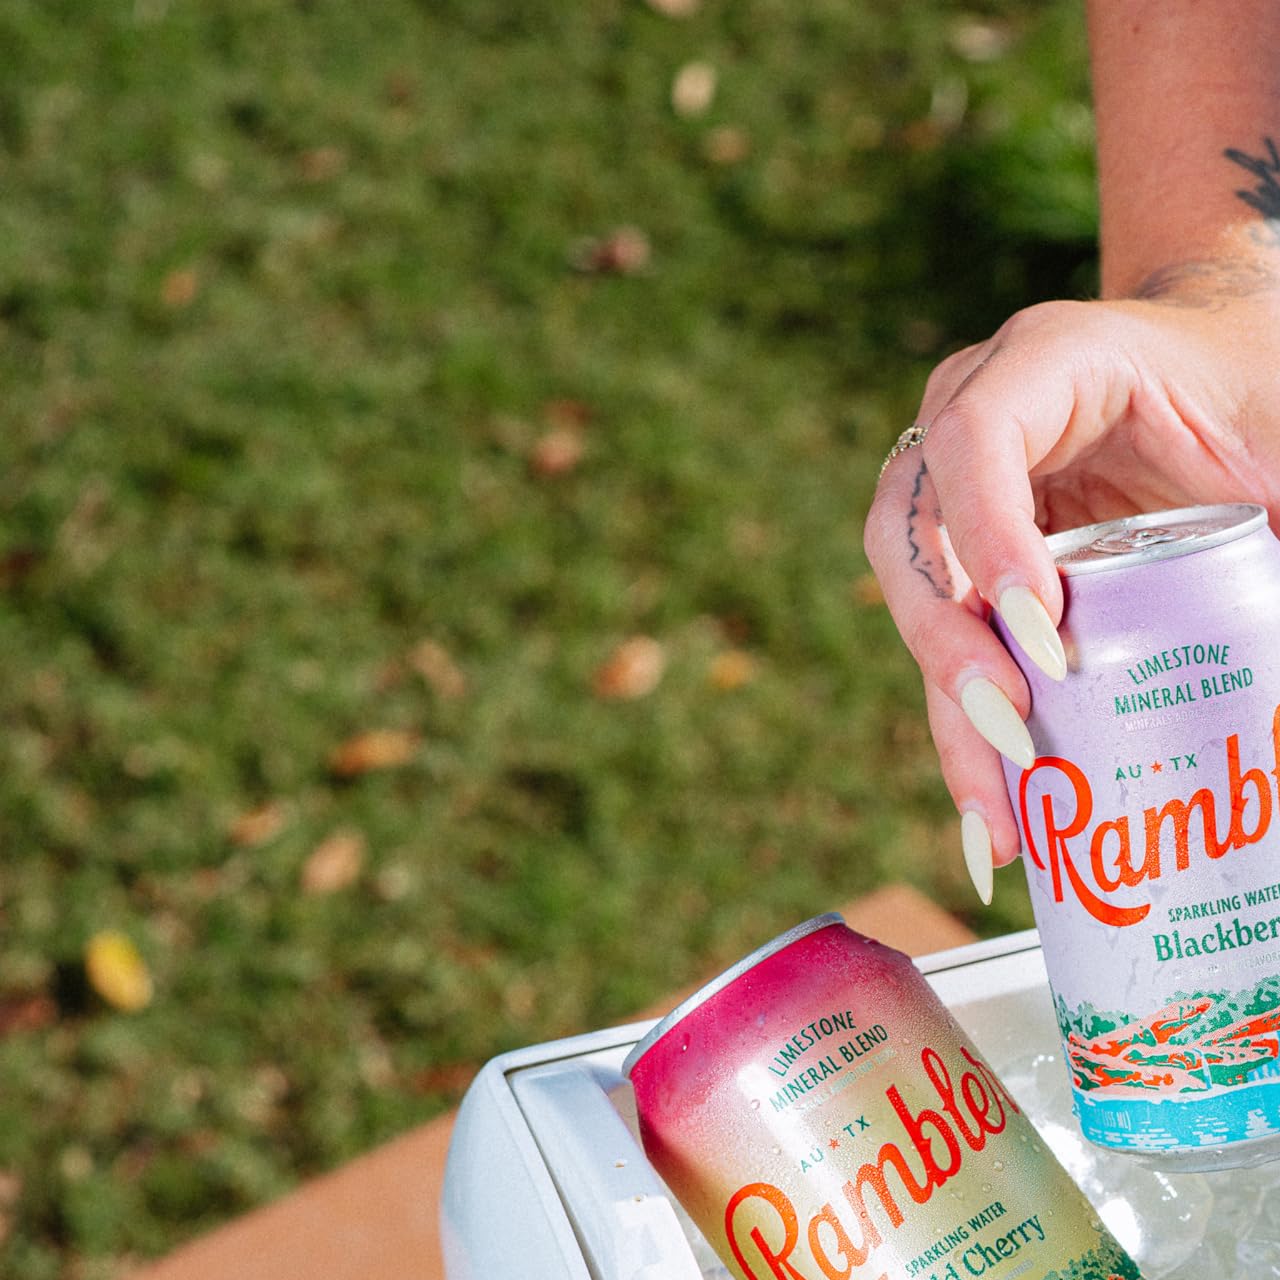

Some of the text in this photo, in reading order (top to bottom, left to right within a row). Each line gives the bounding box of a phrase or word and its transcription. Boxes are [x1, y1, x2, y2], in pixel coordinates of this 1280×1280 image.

[1113, 681, 1197, 717] MINERAL
[1203, 666, 1255, 700] BLEND
[1128, 643, 1231, 686] LIMESTONE
[1115, 753, 1198, 781] AU TX
[1168, 894, 1241, 924] SPARKLING
[768, 1010, 857, 1077] LIMESTONE
[769, 1055, 842, 1112] MINERAL
[838, 1024, 889, 1064] BLEND
[799, 1115, 871, 1173] AU TX
[905, 1201, 1008, 1278] SPARKLING WATER
[962, 1214, 1046, 1277] Cherry
